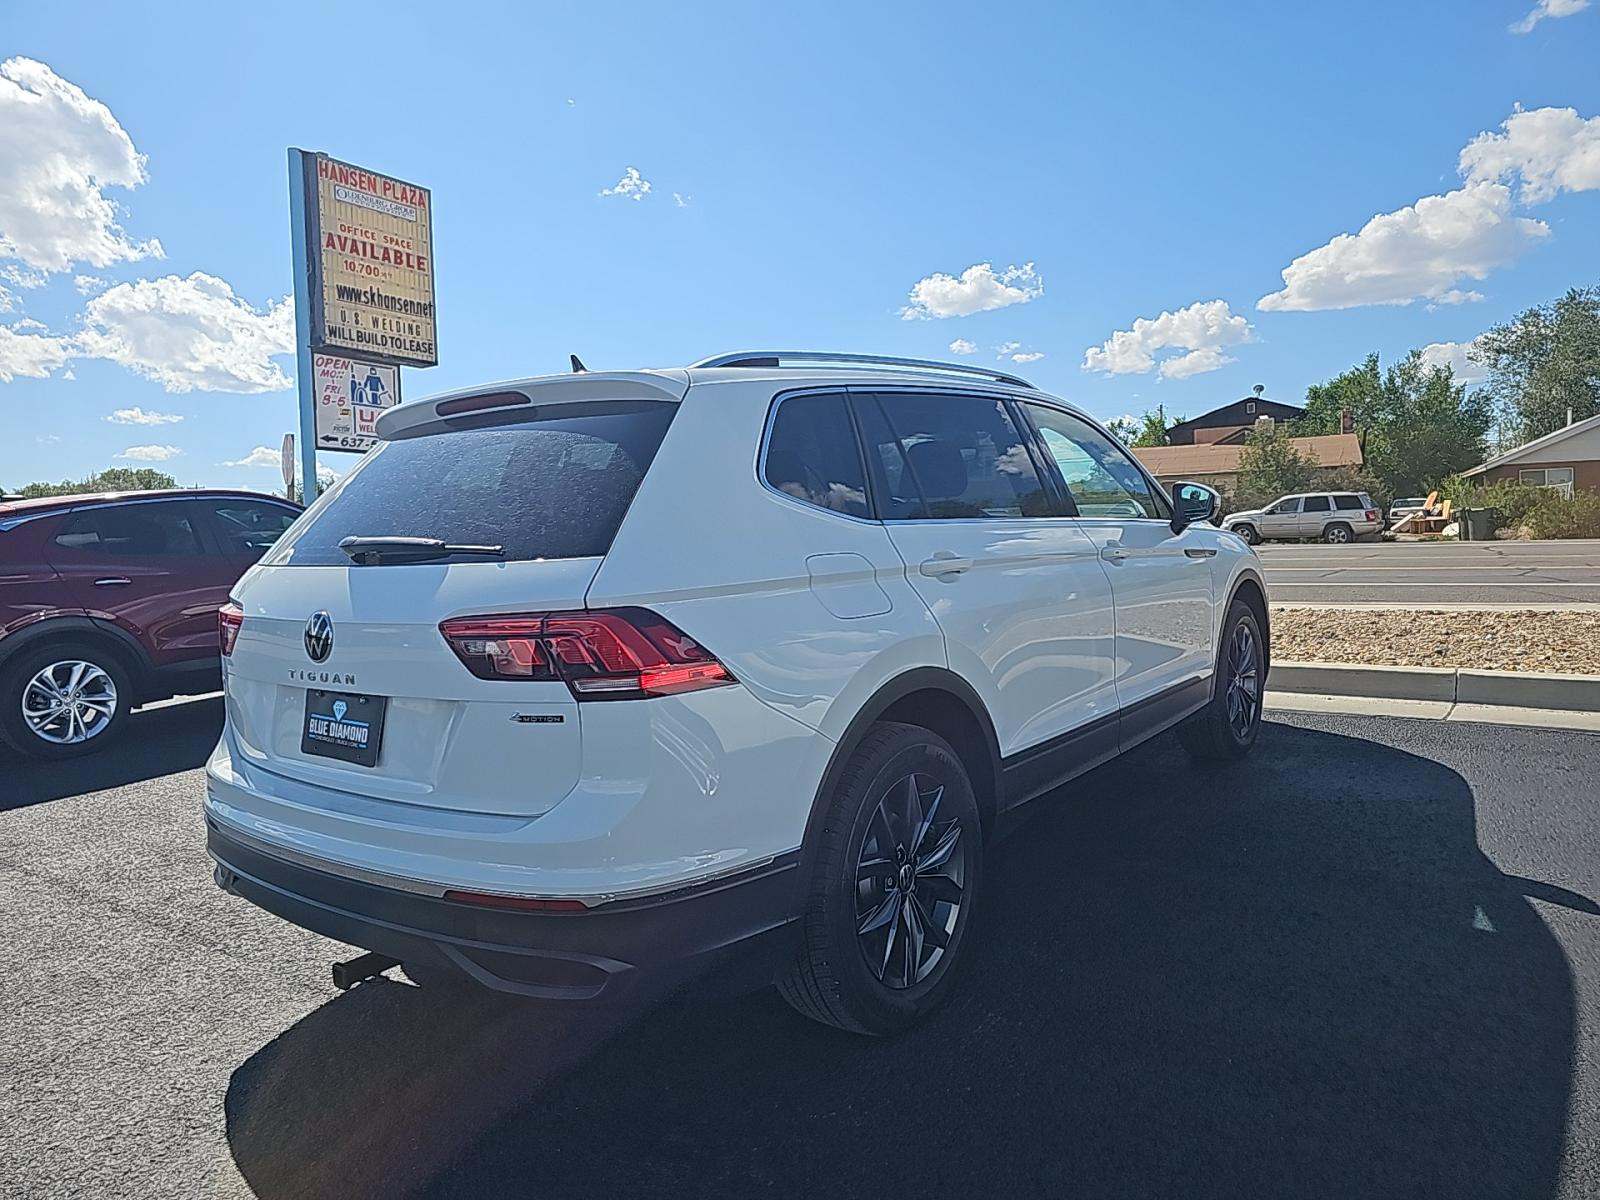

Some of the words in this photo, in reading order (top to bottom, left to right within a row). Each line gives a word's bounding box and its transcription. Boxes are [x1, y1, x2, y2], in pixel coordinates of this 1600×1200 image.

[319, 160, 377, 194] HANSEN
[383, 180, 426, 209] PLAZA
[340, 224, 377, 241] OFFICE
[383, 235, 413, 250] SPACE
[325, 232, 427, 272] AVAILABLE
[372, 315, 421, 337] WELDING
[328, 325, 355, 342] WILL
[357, 330, 388, 347] BUILD
[389, 336, 403, 350] TO
[403, 339, 434, 355] LEASE
[315, 357, 350, 370] OPEN
[324, 384, 342, 394] FRI
[288, 669, 355, 685] TIGUAN
[309, 719, 329, 736] BLUE
[329, 722, 369, 743] DIAMOND
